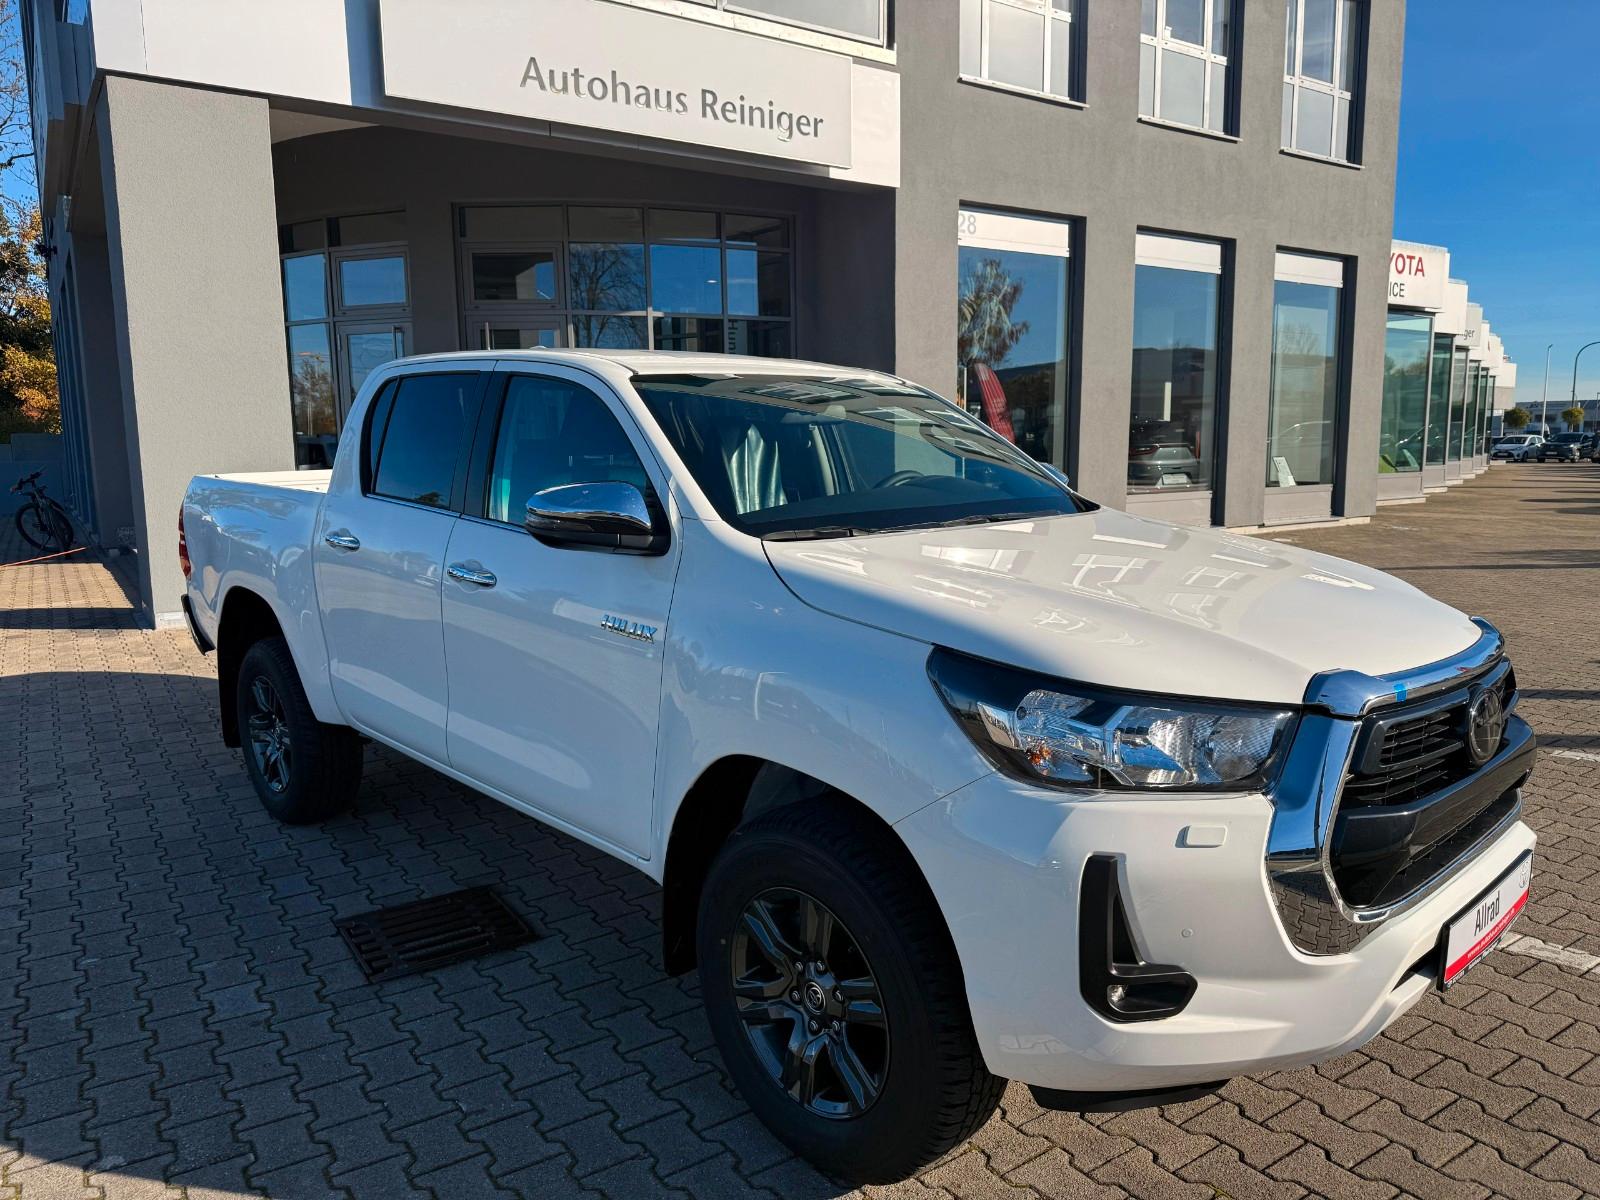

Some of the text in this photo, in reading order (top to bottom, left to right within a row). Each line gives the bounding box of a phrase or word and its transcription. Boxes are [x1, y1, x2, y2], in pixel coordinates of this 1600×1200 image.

[520, 56, 824, 142] Autohaus Reiniger
[600, 614, 657, 644] HILUX
[1474, 890, 1500, 936] Allrad
